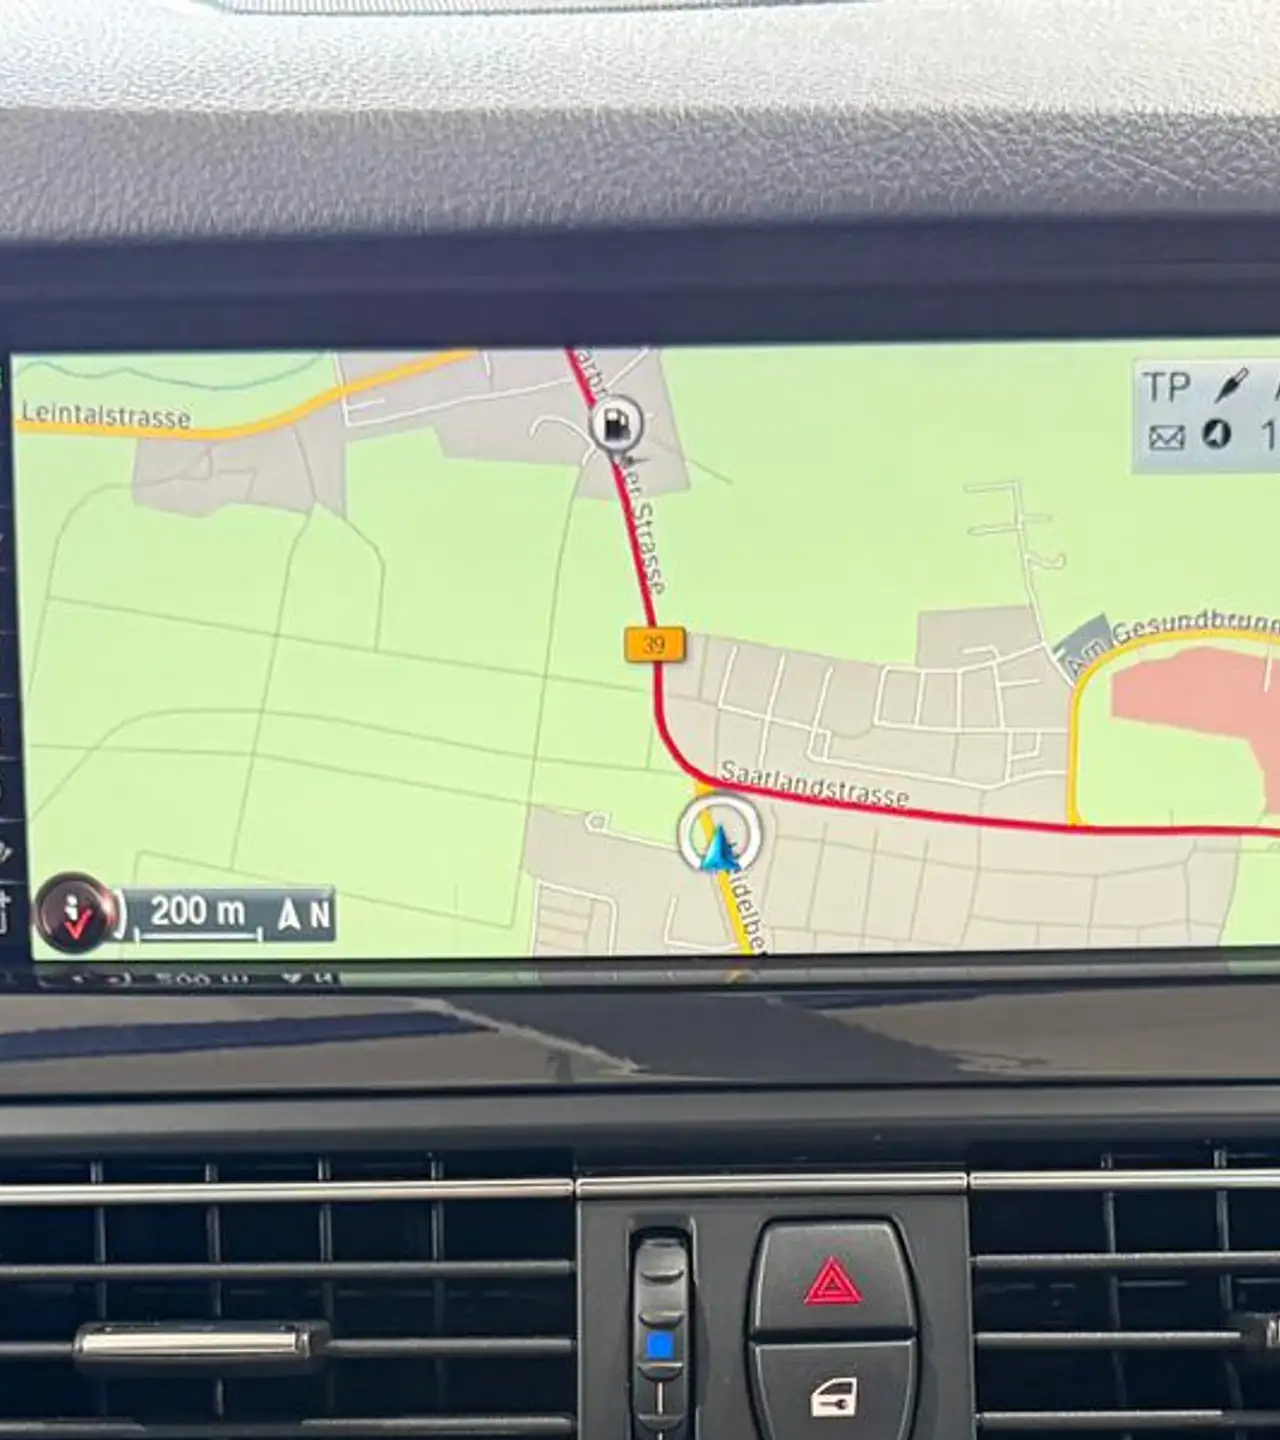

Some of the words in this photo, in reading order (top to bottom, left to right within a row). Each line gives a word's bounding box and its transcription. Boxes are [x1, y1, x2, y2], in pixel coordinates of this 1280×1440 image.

[1141, 371, 1192, 403] TP
[21, 400, 193, 430] Leintalstrasse
[631, 502, 666, 596] Strasse
[642, 635, 666, 655] 39
[1065, 638, 1106, 678] Am
[721, 759, 910, 808] Saarlandstrasse
[151, 895, 207, 926] 200
[217, 901, 246, 926] m
[309, 901, 331, 929] N
